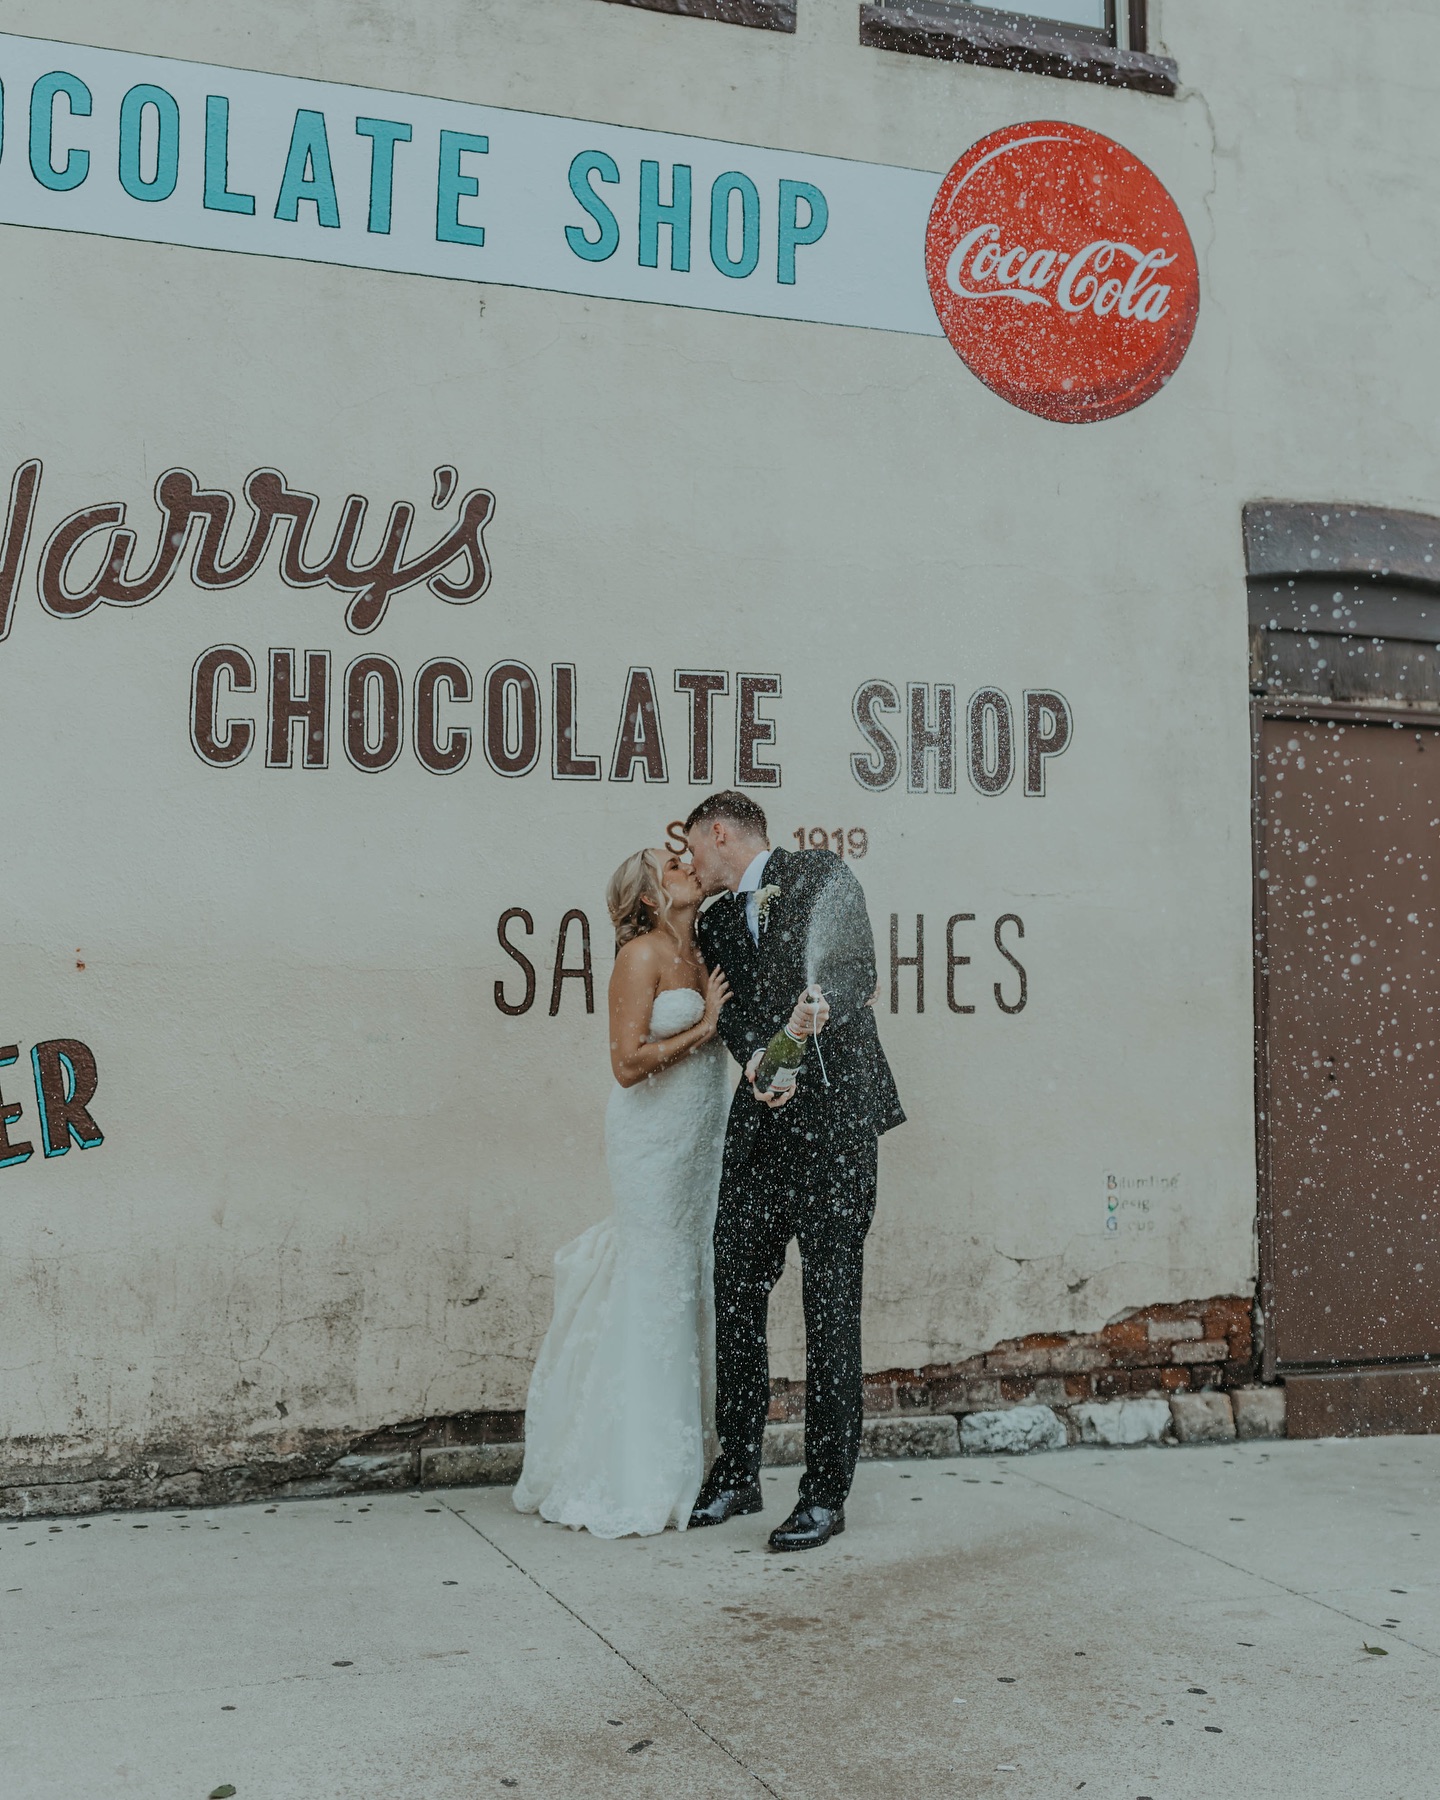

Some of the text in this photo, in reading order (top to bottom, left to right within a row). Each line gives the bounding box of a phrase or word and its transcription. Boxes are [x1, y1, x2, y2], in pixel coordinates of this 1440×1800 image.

[0, 71, 829, 286] COLATE SHOP
[946, 223, 1178, 323] Coca-Cola
[189, 643, 1074, 798] CHOCOLATE SHOP
[793, 826, 868, 859] 1919
